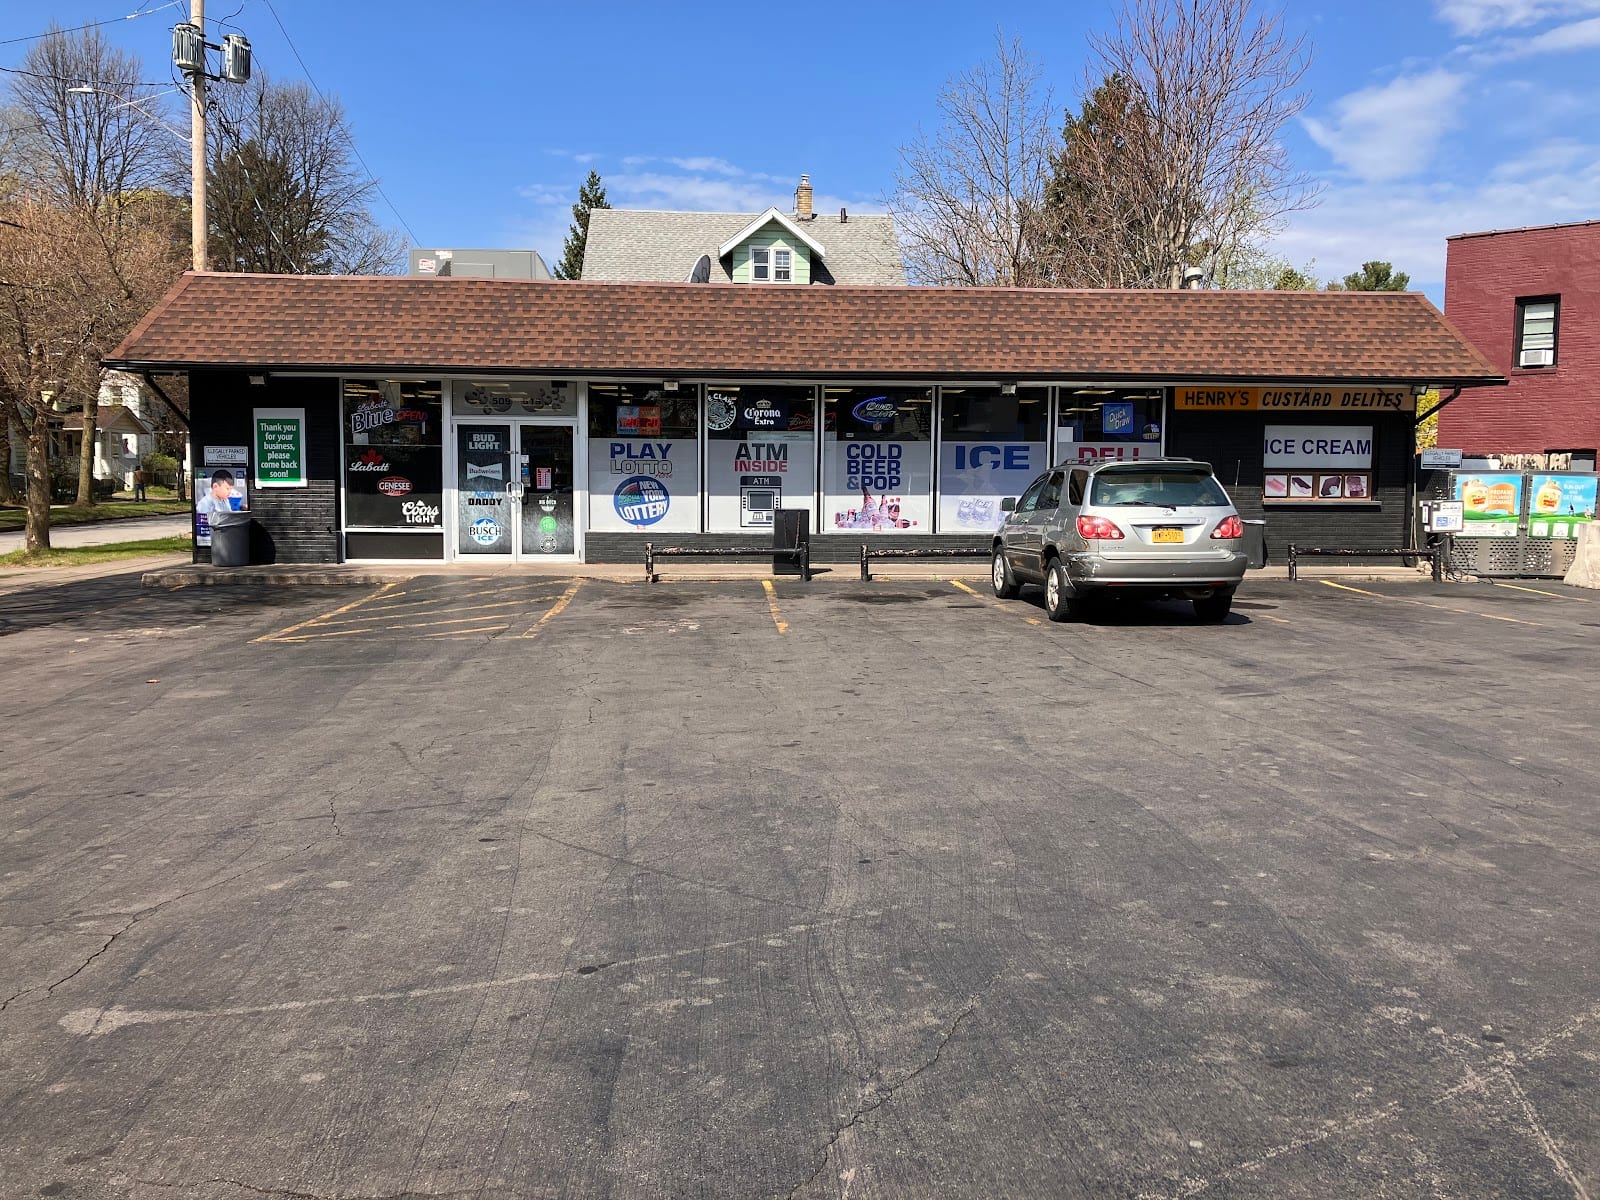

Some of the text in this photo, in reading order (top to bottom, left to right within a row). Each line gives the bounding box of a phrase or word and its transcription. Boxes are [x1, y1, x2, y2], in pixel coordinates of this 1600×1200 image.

[1185, 390, 1404, 407] HENRY'S CUSTARD DELITES
[744, 408, 781, 419] Corona
[1109, 409, 1126, 422] Quick
[351, 409, 394, 434] Blue
[754, 417, 775, 425] Extra
[1114, 416, 1131, 430] Draw
[260, 422, 297, 433] Thank you
[265, 432, 293, 442] for your
[472, 433, 496, 442] BUD
[263, 441, 296, 451] business,
[468, 441, 501, 450] LIGHT
[610, 442, 672, 459] PLAY
[1264, 439, 1371, 455] ICE CREAM
[267, 451, 290, 461] please
[735, 443, 788, 460] ATM
[846, 444, 902, 460] COLD
[955, 445, 1030, 469] ICE
[280, 460, 298, 469] back
[349, 461, 391, 472] Labatt
[610, 459, 673, 474] LOTTO
[734, 460, 788, 472] INSIDE
[847, 460, 901, 475] BEER
[269, 470, 289, 478] soon!
[378, 482, 411, 491] GENESEE
[640, 481, 659, 490] NEW
[752, 477, 770, 485] ATM
[642, 490, 666, 502] YORK
[468, 498, 503, 506] DADDY
[402, 501, 440, 516] Coors
[619, 501, 668, 520] LOTTERY
[406, 515, 436, 523] LIGHT
[469, 526, 502, 536] BUSCH
